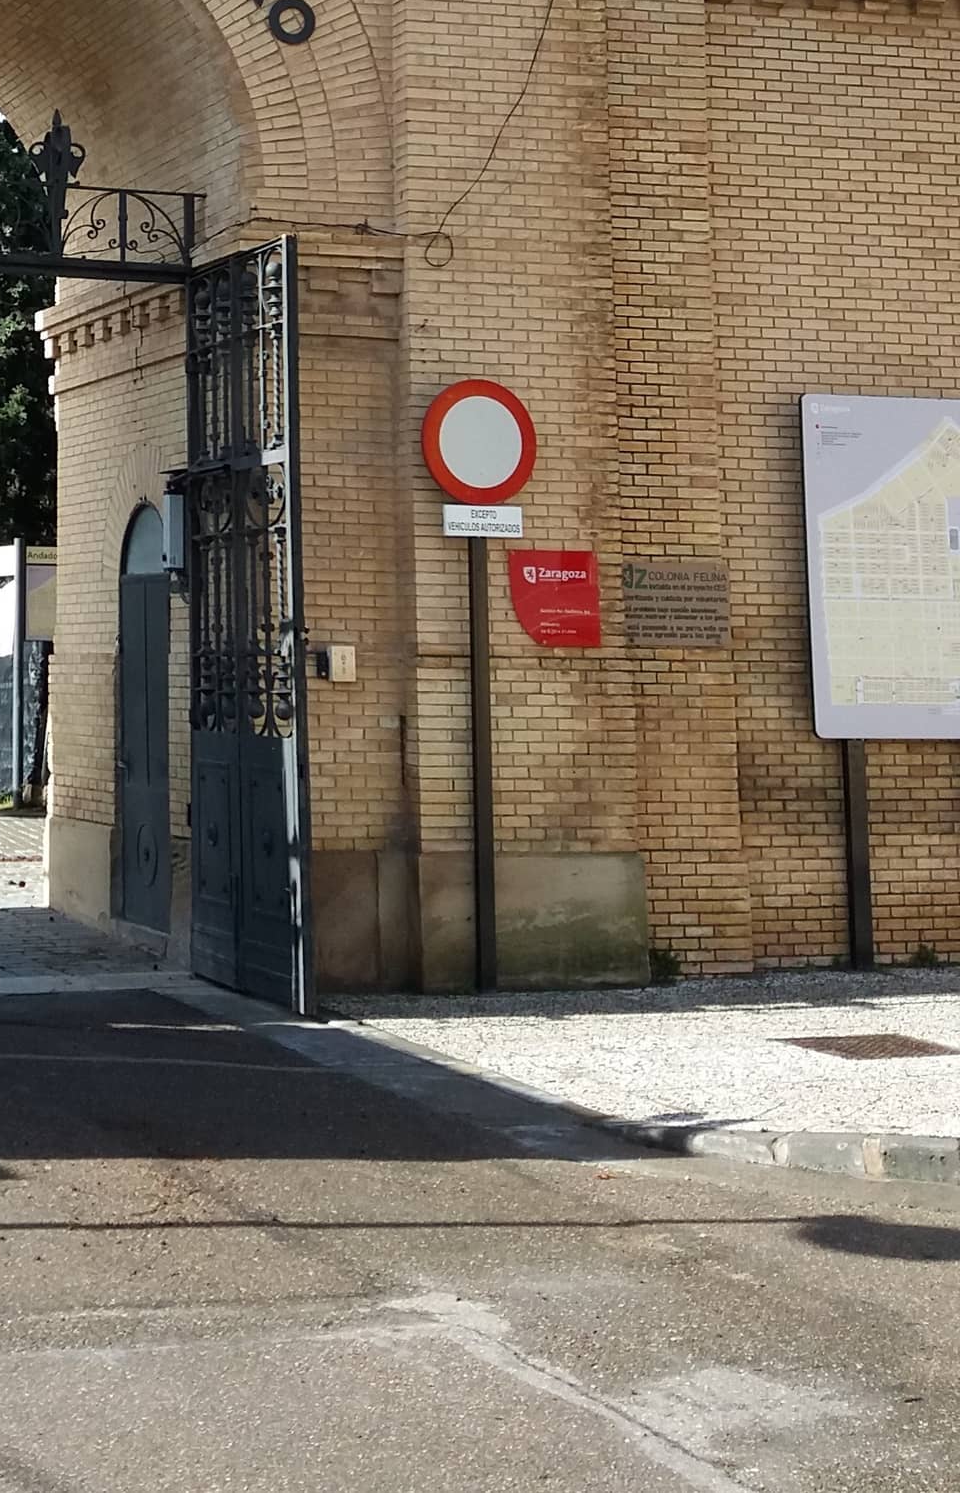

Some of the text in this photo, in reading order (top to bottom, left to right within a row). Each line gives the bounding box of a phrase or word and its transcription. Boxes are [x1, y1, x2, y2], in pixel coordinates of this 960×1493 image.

[471, 509, 497, 519] EXCEPTO
[481, 523, 521, 533] AUTORIZADOS
[538, 567, 587, 581] Zaragoza
[648, 571, 727, 582] COLONIA FELINA
